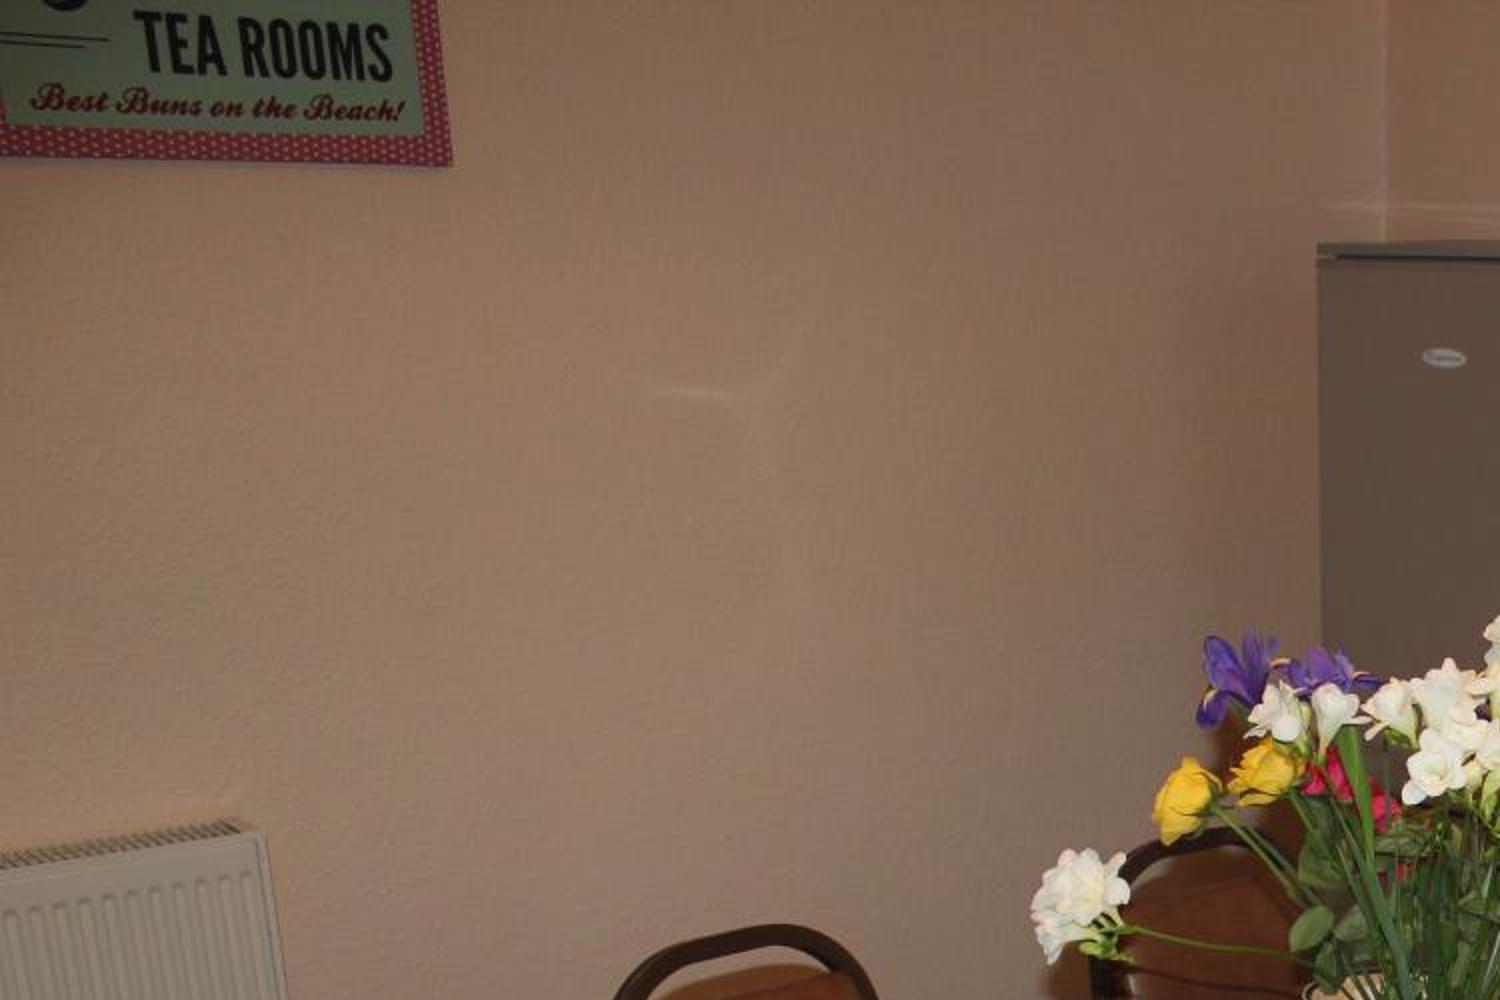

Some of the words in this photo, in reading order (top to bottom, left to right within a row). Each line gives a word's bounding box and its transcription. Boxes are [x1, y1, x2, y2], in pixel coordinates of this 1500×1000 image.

[134, 10, 228, 77] TEA
[237, 17, 394, 82] ROOMS
[30, 82, 108, 112] Best
[115, 86, 204, 115] Buns
[210, 102, 244, 118] on
[251, 95, 298, 119] the
[303, 94, 406, 122] Beach!
